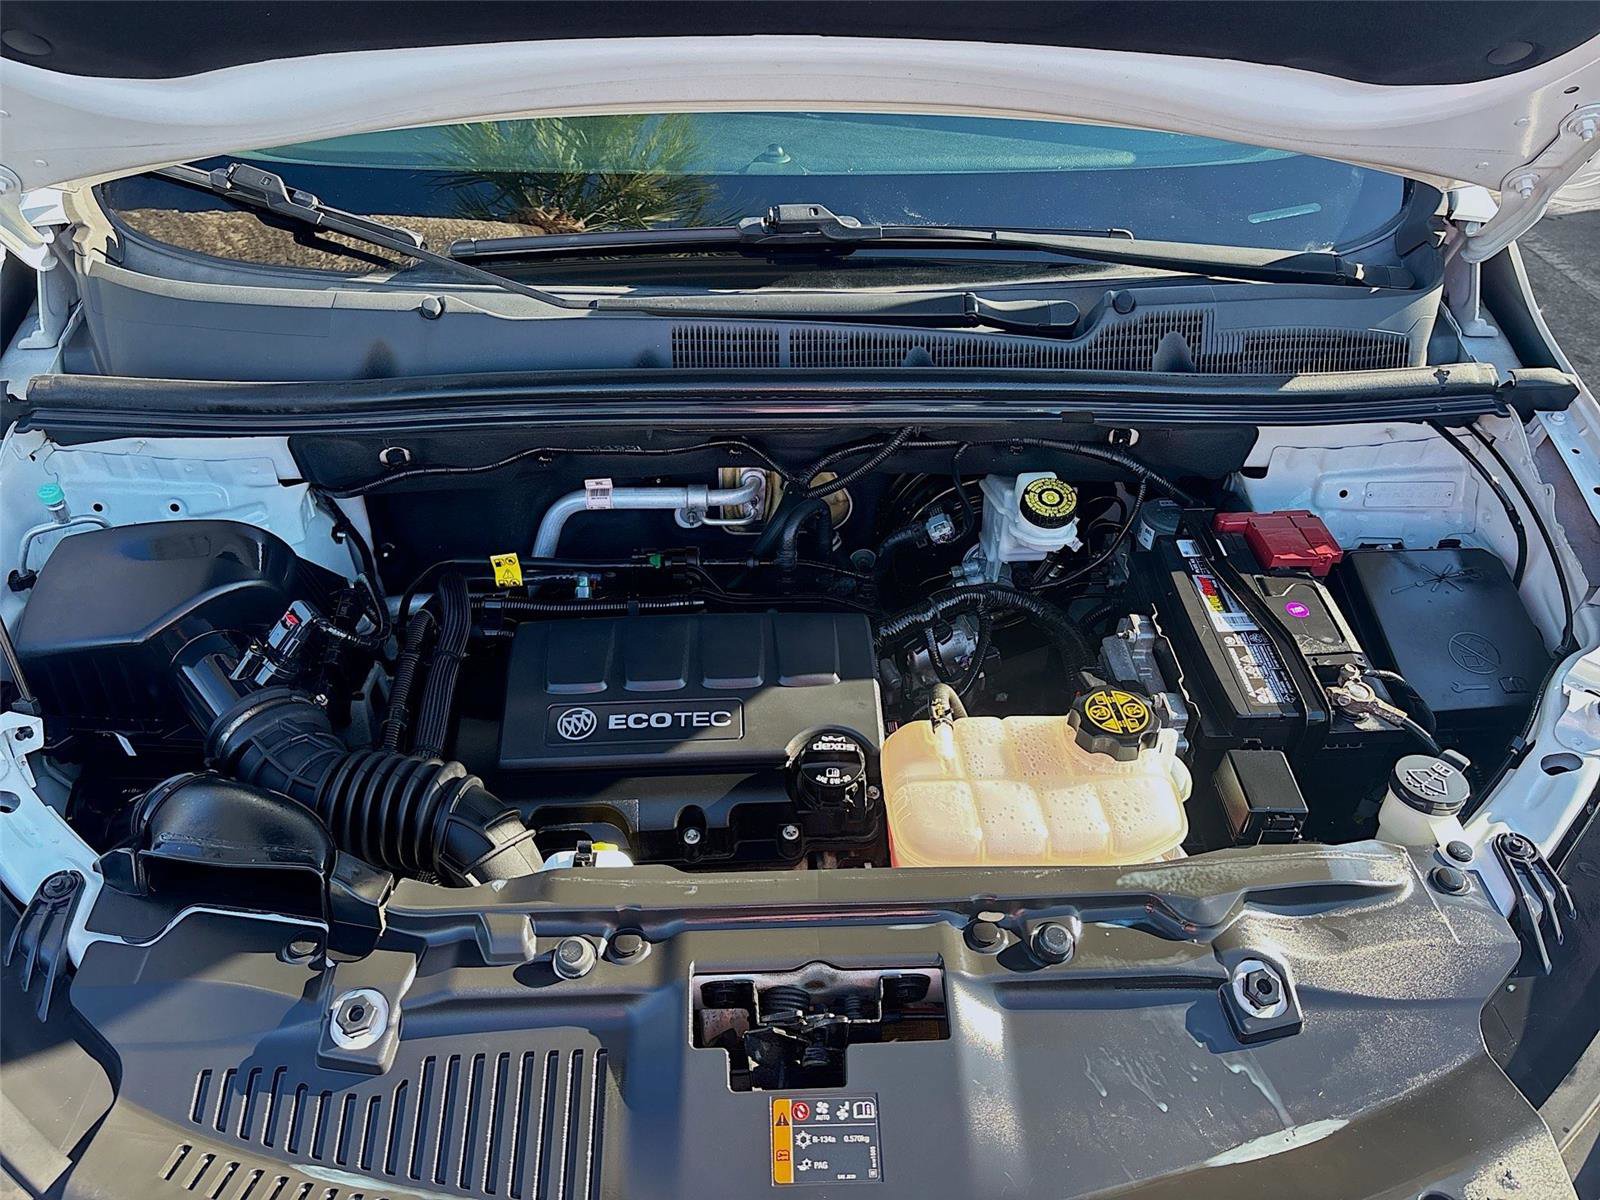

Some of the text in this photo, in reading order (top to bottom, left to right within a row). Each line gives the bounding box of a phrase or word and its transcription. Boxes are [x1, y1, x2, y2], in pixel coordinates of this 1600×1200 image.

[608, 711, 732, 729] ECOTEC
[813, 741, 855, 751] dexos
[812, 1135, 836, 1143] R-134a
[813, 1161, 829, 1169] PAG
